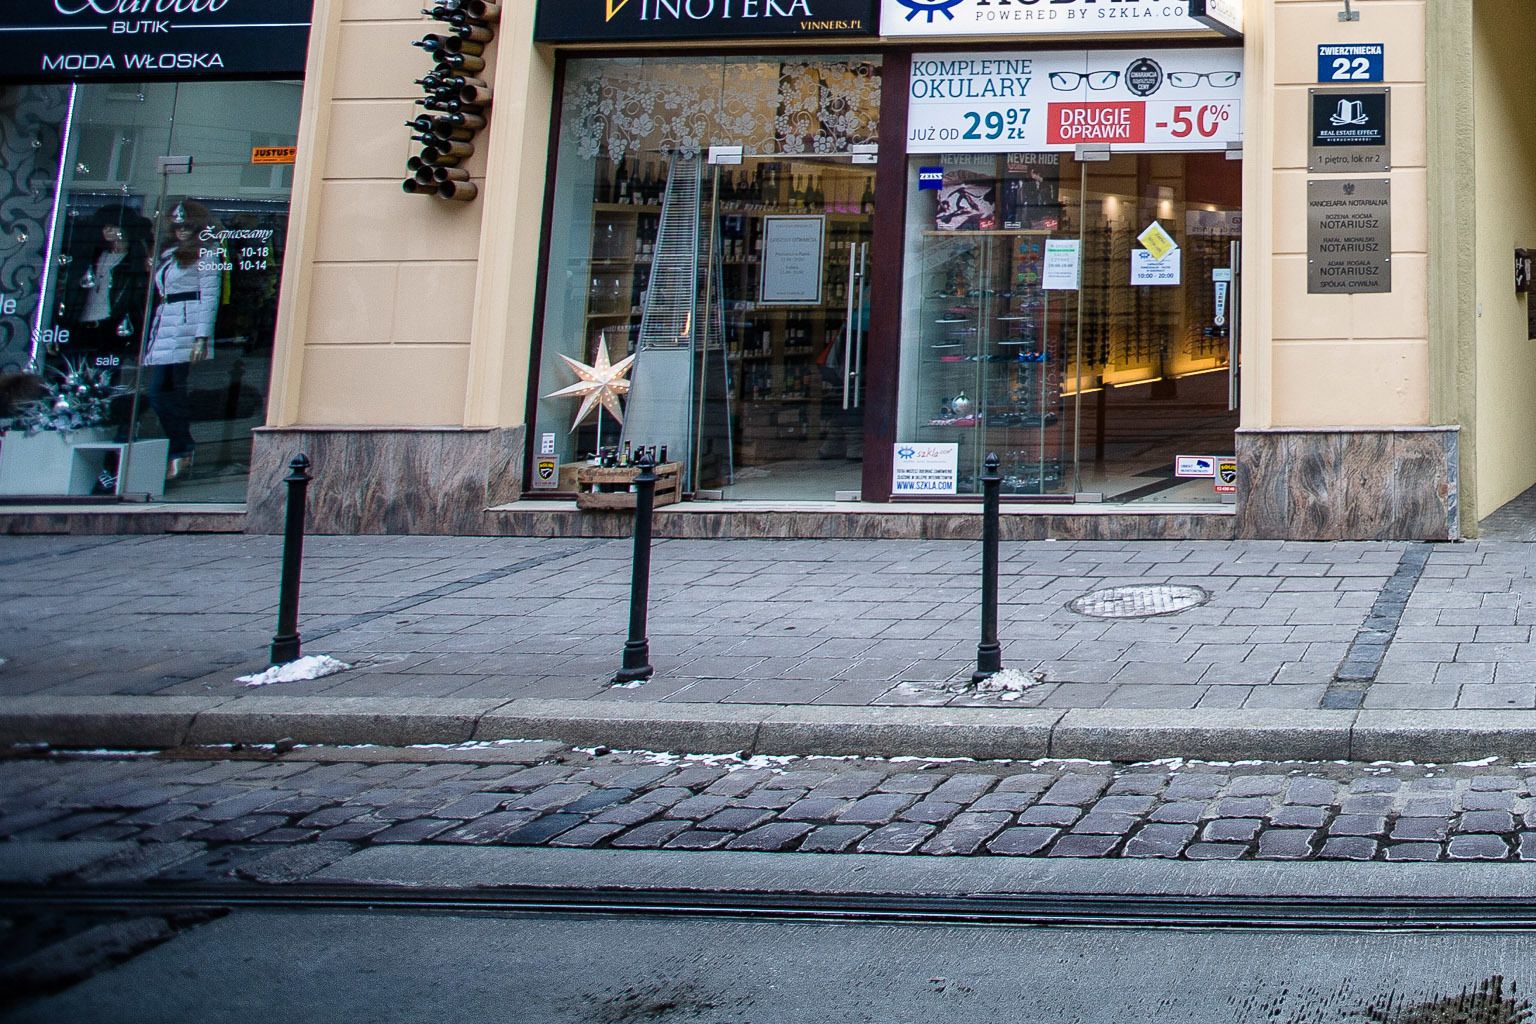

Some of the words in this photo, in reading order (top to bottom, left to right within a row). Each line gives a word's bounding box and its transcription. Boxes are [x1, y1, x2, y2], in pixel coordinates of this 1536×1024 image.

[976, 9, 1057, 21] POWERED
[1068, 8, 1088, 19] BY
[1098, 6, 1184, 18] SZKLA.CO
[112, 20, 170, 34] BUTIK
[800, 19, 863, 31] VINNERS.PL
[1320, 46, 1382, 55] ZWIERZYNIECKA
[42, 54, 116, 70] MODA
[124, 53, 224, 69] WŁOSKA
[912, 60, 1032, 76] KOMPLETNE
[1332, 57, 1370, 79] 22
[912, 78, 1031, 98] OKULARY
[1060, 108, 1131, 126] DRUGIE
[910, 126, 935, 140] JUŻ
[940, 129, 959, 140] OD
[1059, 125, 1130, 139] OPRAWKI
[254, 148, 289, 157] JUSTUS
[941, 154, 972, 165] NEVER
[974, 154, 995, 165] HIDE
[1007, 153, 1037, 164] NEVER
[1038, 153, 1059, 165] HIDE
[1351, 155, 1364, 163] lok
[1320, 220, 1379, 229] NOTARIUSZ
[200, 247, 227, 258] Pn-Pt
[241, 247, 269, 257] 10-18
[1320, 243, 1379, 253] NOTARIUSZ
[198, 261, 233, 271] Sobota
[239, 260, 267, 271] 10-14
[1320, 267, 1379, 276] NOTARIUSZ
[0, 293, 17, 315] le
[32, 325, 70, 343] sale
[96, 355, 120, 366] sale
[896, 481, 953, 490] WWW.SZKLA.COM
